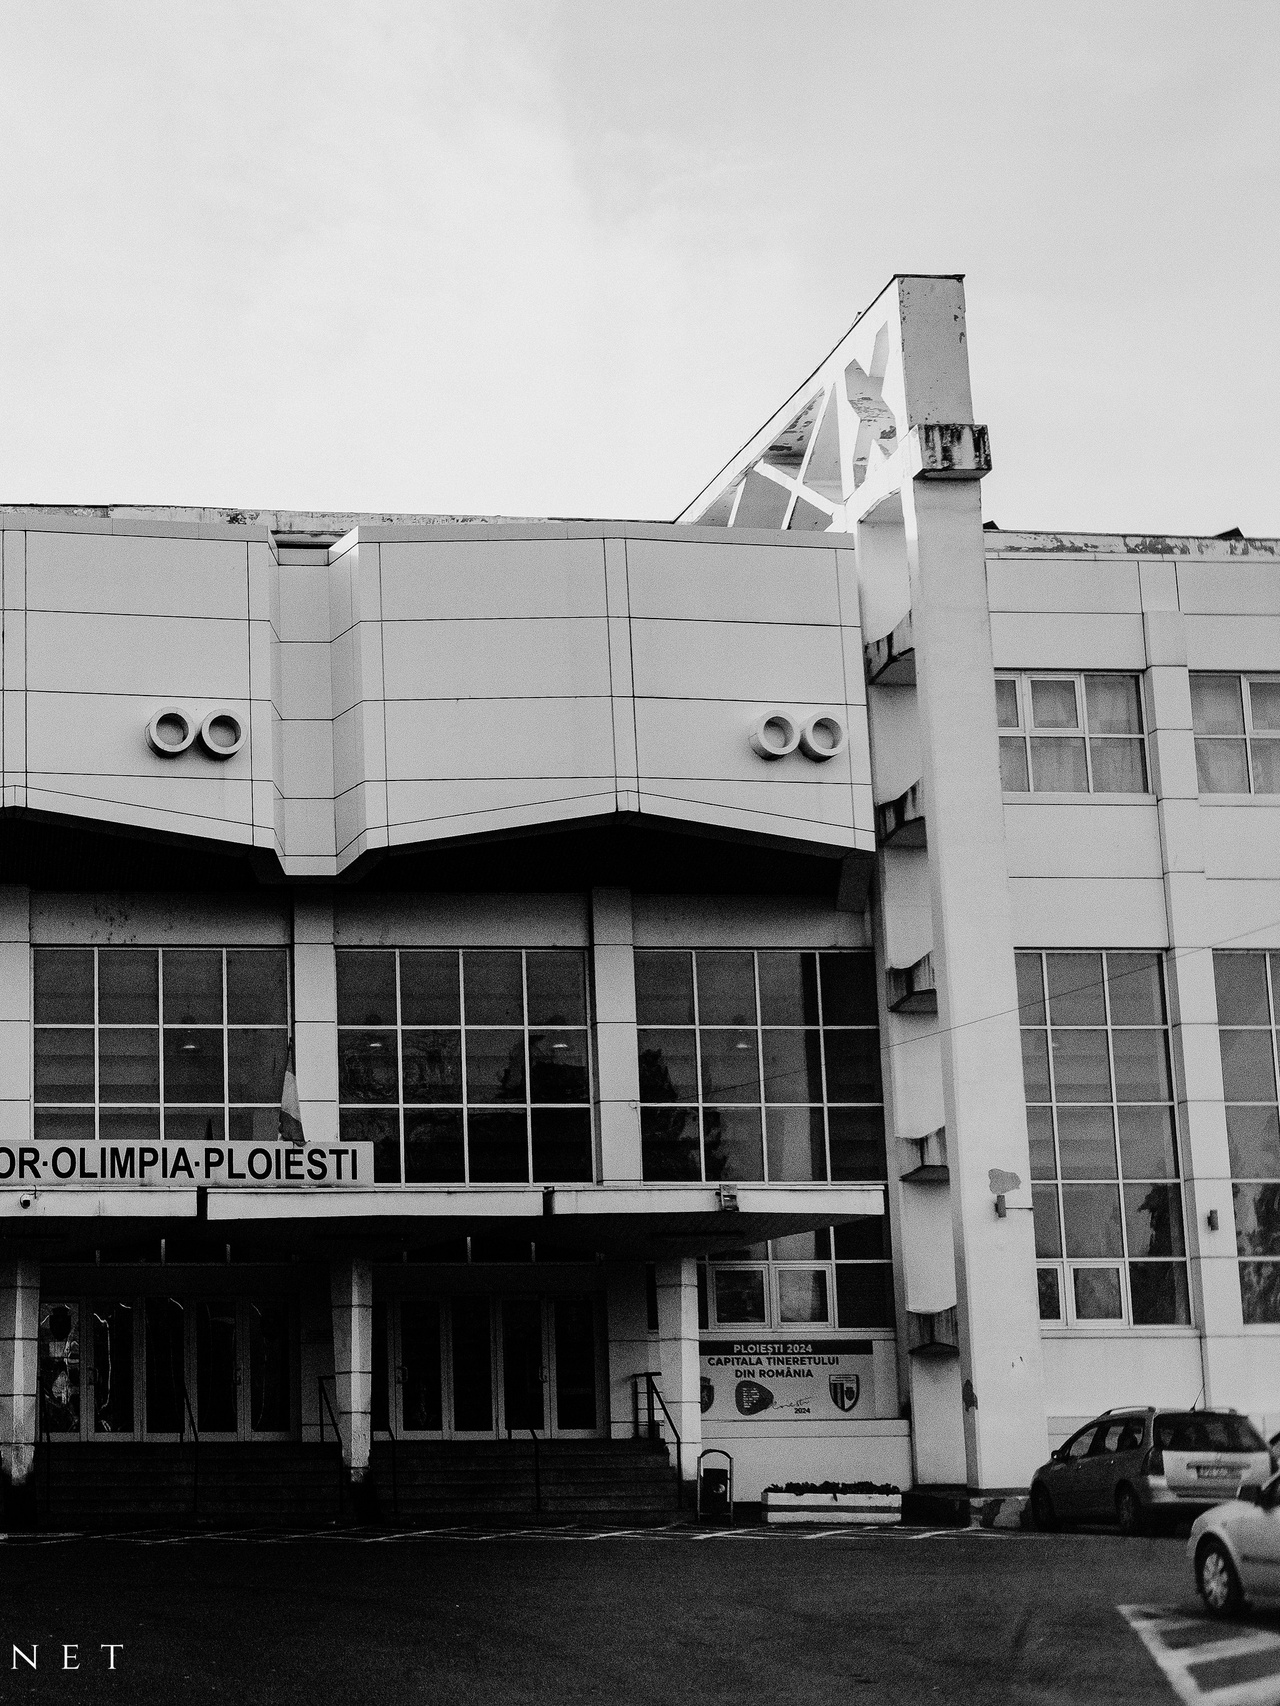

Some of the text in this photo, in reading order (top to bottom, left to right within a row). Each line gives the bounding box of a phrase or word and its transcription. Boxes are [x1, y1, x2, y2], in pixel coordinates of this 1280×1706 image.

[786, 1343, 813, 1353] 2024
[707, 1356, 840, 1366] CAPITALA TINERETULUI
[734, 1367, 814, 1378] DIN ROMÂNIA
